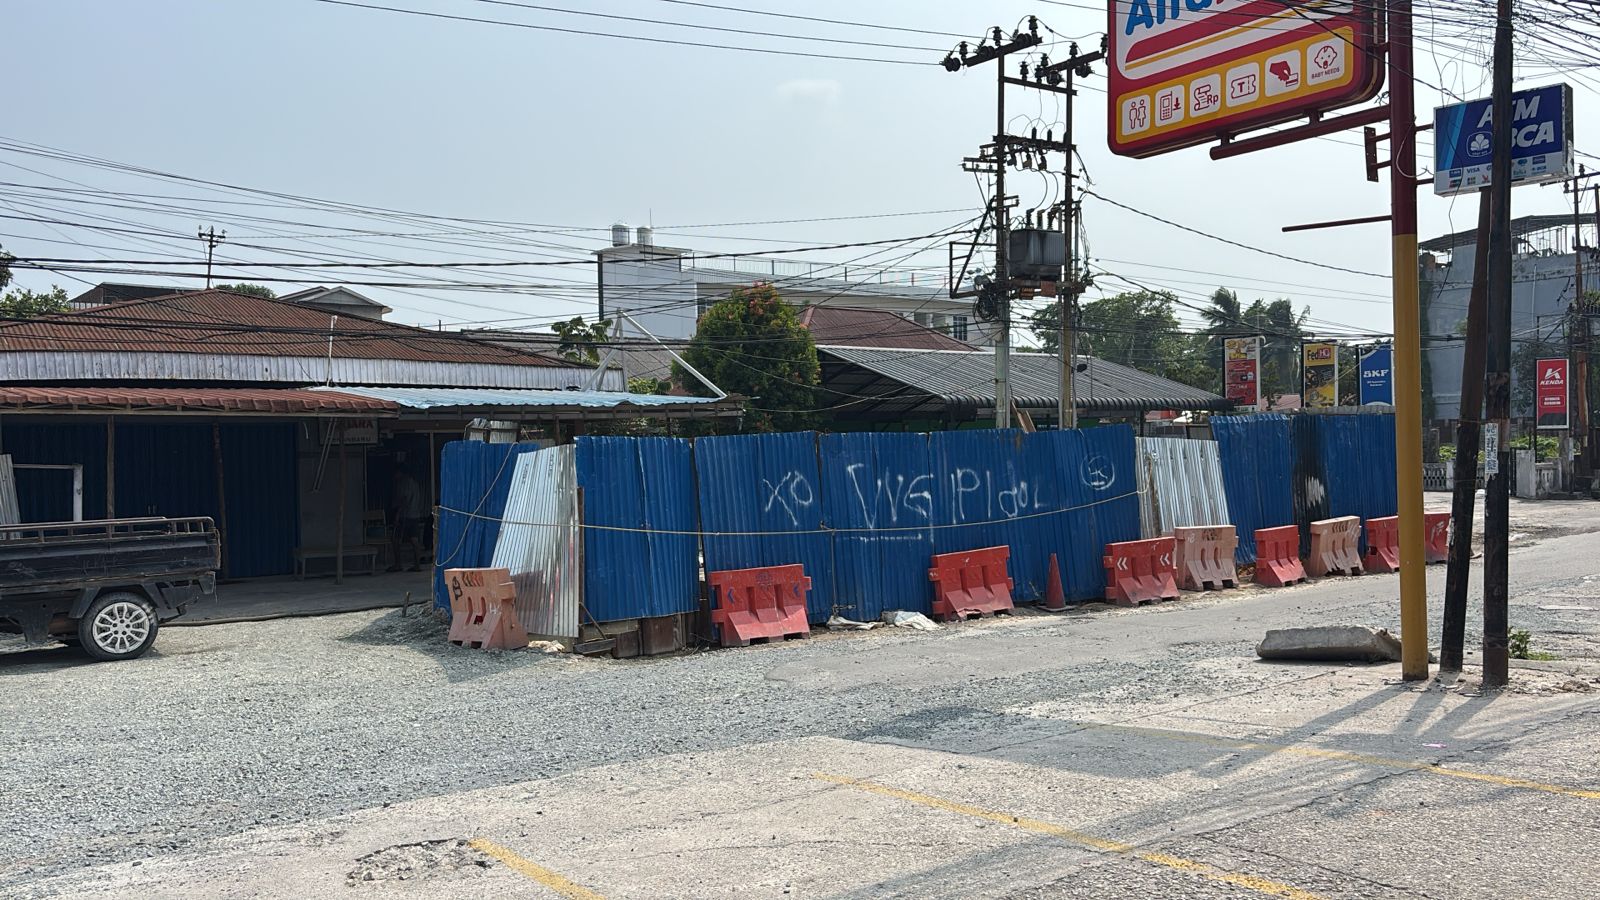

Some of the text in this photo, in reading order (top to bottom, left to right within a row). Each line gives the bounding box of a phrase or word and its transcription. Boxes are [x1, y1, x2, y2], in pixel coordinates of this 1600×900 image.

[1311, 66, 1340, 79] BABY NEEDS
[1207, 93, 1219, 106] Rp
[1466, 166, 1480, 174] VISA
[1363, 369, 1390, 378] SKF
